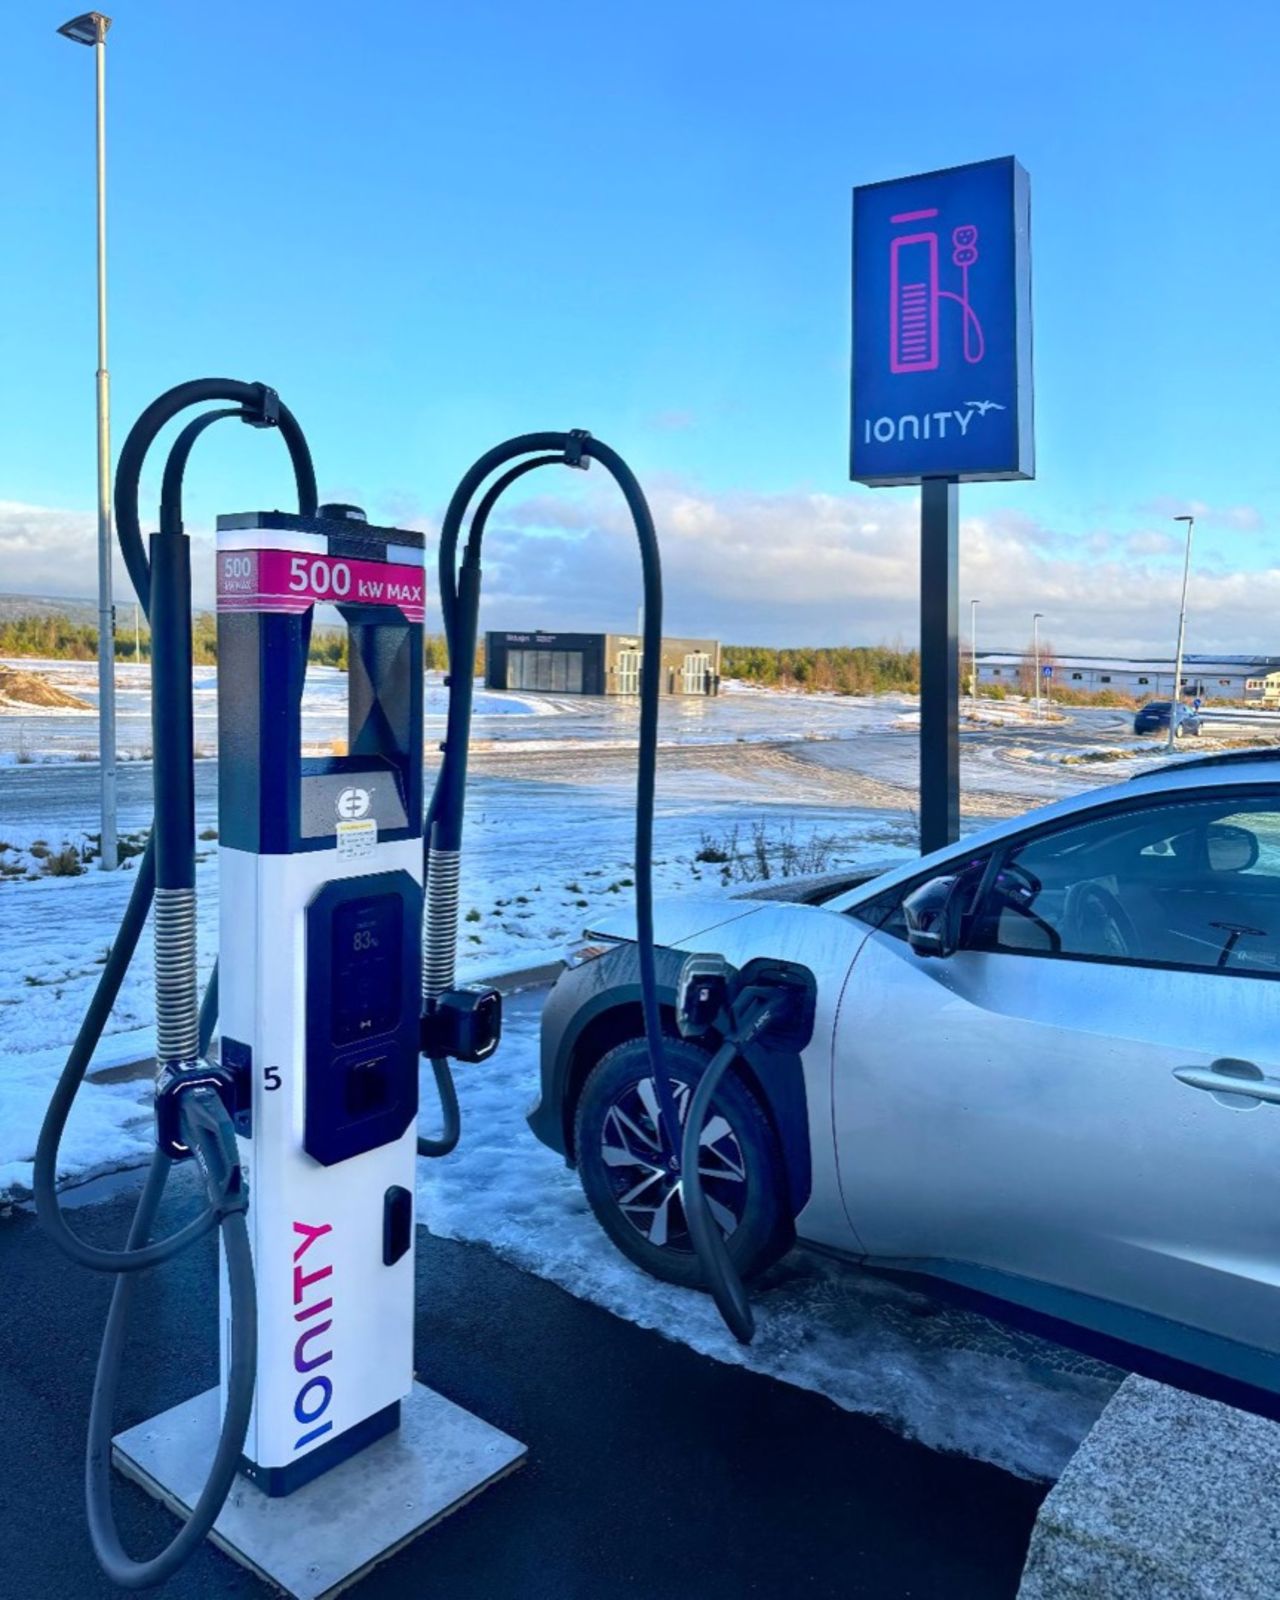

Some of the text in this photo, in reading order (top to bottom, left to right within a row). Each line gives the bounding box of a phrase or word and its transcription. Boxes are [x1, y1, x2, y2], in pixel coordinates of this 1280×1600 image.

[865, 409, 975, 444] IONITY
[224, 557, 251, 577] 500
[289, 557, 422, 602] 500 kW MAX
[264, 1065, 282, 1091] 5
[293, 1221, 333, 1451] IONITY
